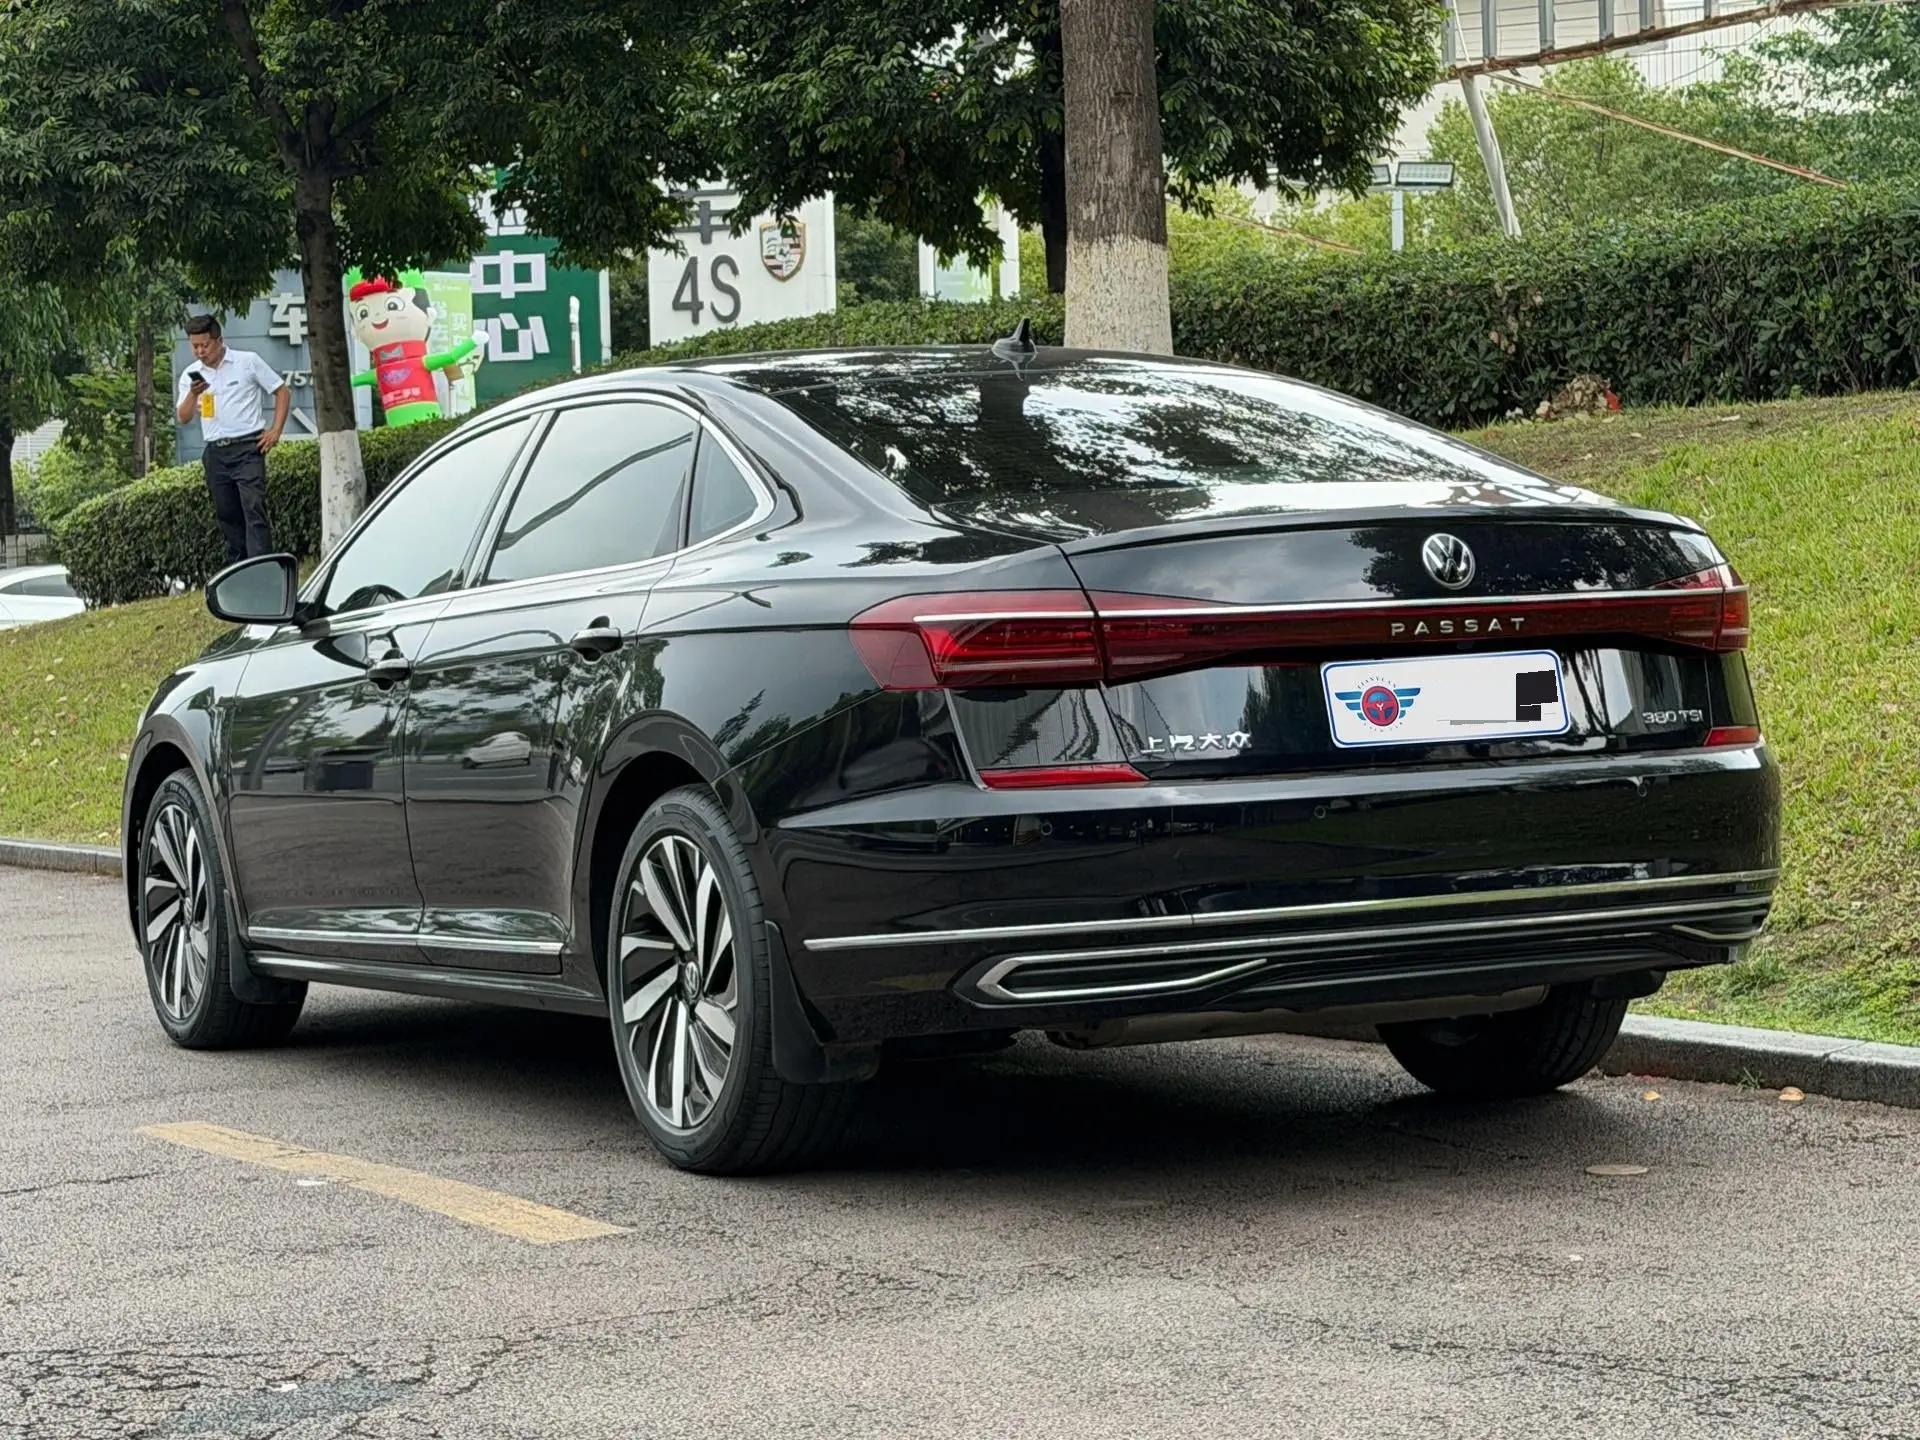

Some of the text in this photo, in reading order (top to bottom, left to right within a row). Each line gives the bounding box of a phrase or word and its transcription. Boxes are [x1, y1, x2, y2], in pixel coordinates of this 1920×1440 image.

[672, 254, 741, 325] 4S
[1391, 617, 1525, 636] PASSAT
[1642, 709, 1704, 724] 380 TSI
[1140, 731, 1252, 753] 上汽大众
